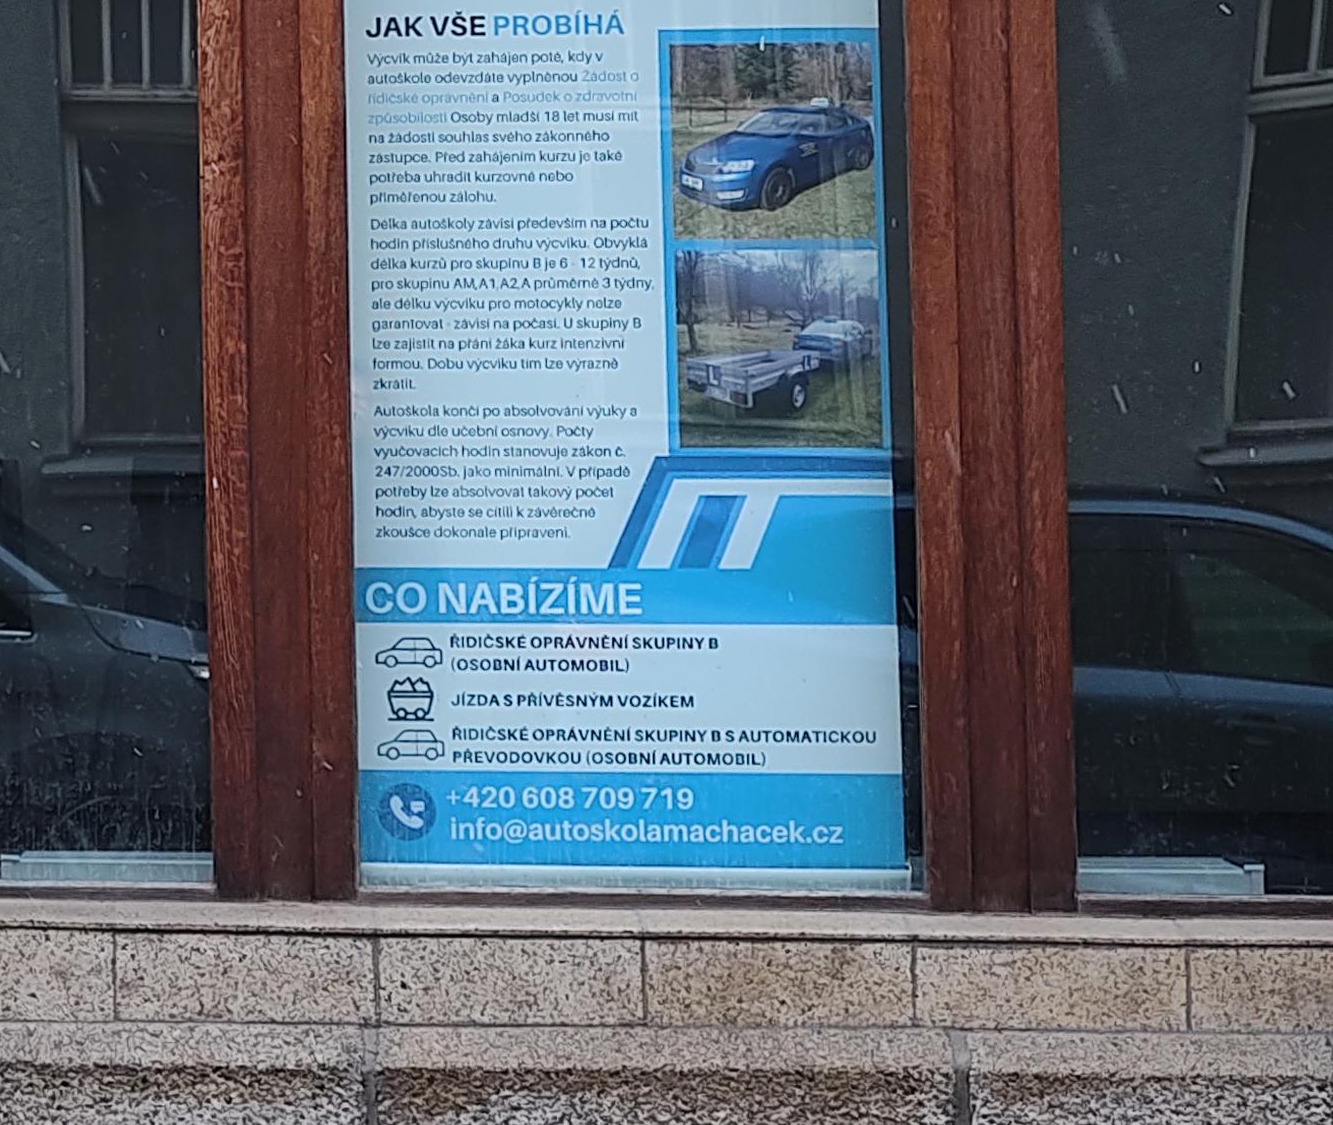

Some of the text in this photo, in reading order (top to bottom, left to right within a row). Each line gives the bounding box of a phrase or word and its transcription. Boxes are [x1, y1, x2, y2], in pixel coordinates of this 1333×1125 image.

[366, 9, 624, 38] JAK VŠE PROBÍHÁ
[709, 366, 719, 385] L
[364, 577, 642, 616] CO NABÍZÍME
[450, 633, 718, 649] ŘIDIČSKÉ OPRÁVNĚNÍ SKUPINY B
[451, 657, 629, 672] (OSOBNÍ AUTOMOBIL)
[451, 691, 694, 708] JÍZDA S PŘÍVĚSNÝM VOZÍKEM
[452, 726, 877, 744] ŘIDIČSKÉ OPRÁVNĚNÍ SKUPINY B S AUTOMATICKOU
[453, 749, 766, 767] PŘEVODOVKOU (OSOBNÍ AUTOMOBIL)
[446, 787, 694, 810] +420 608 709 719
[450, 818, 844, 844] info@autoskolamachacek.cz
